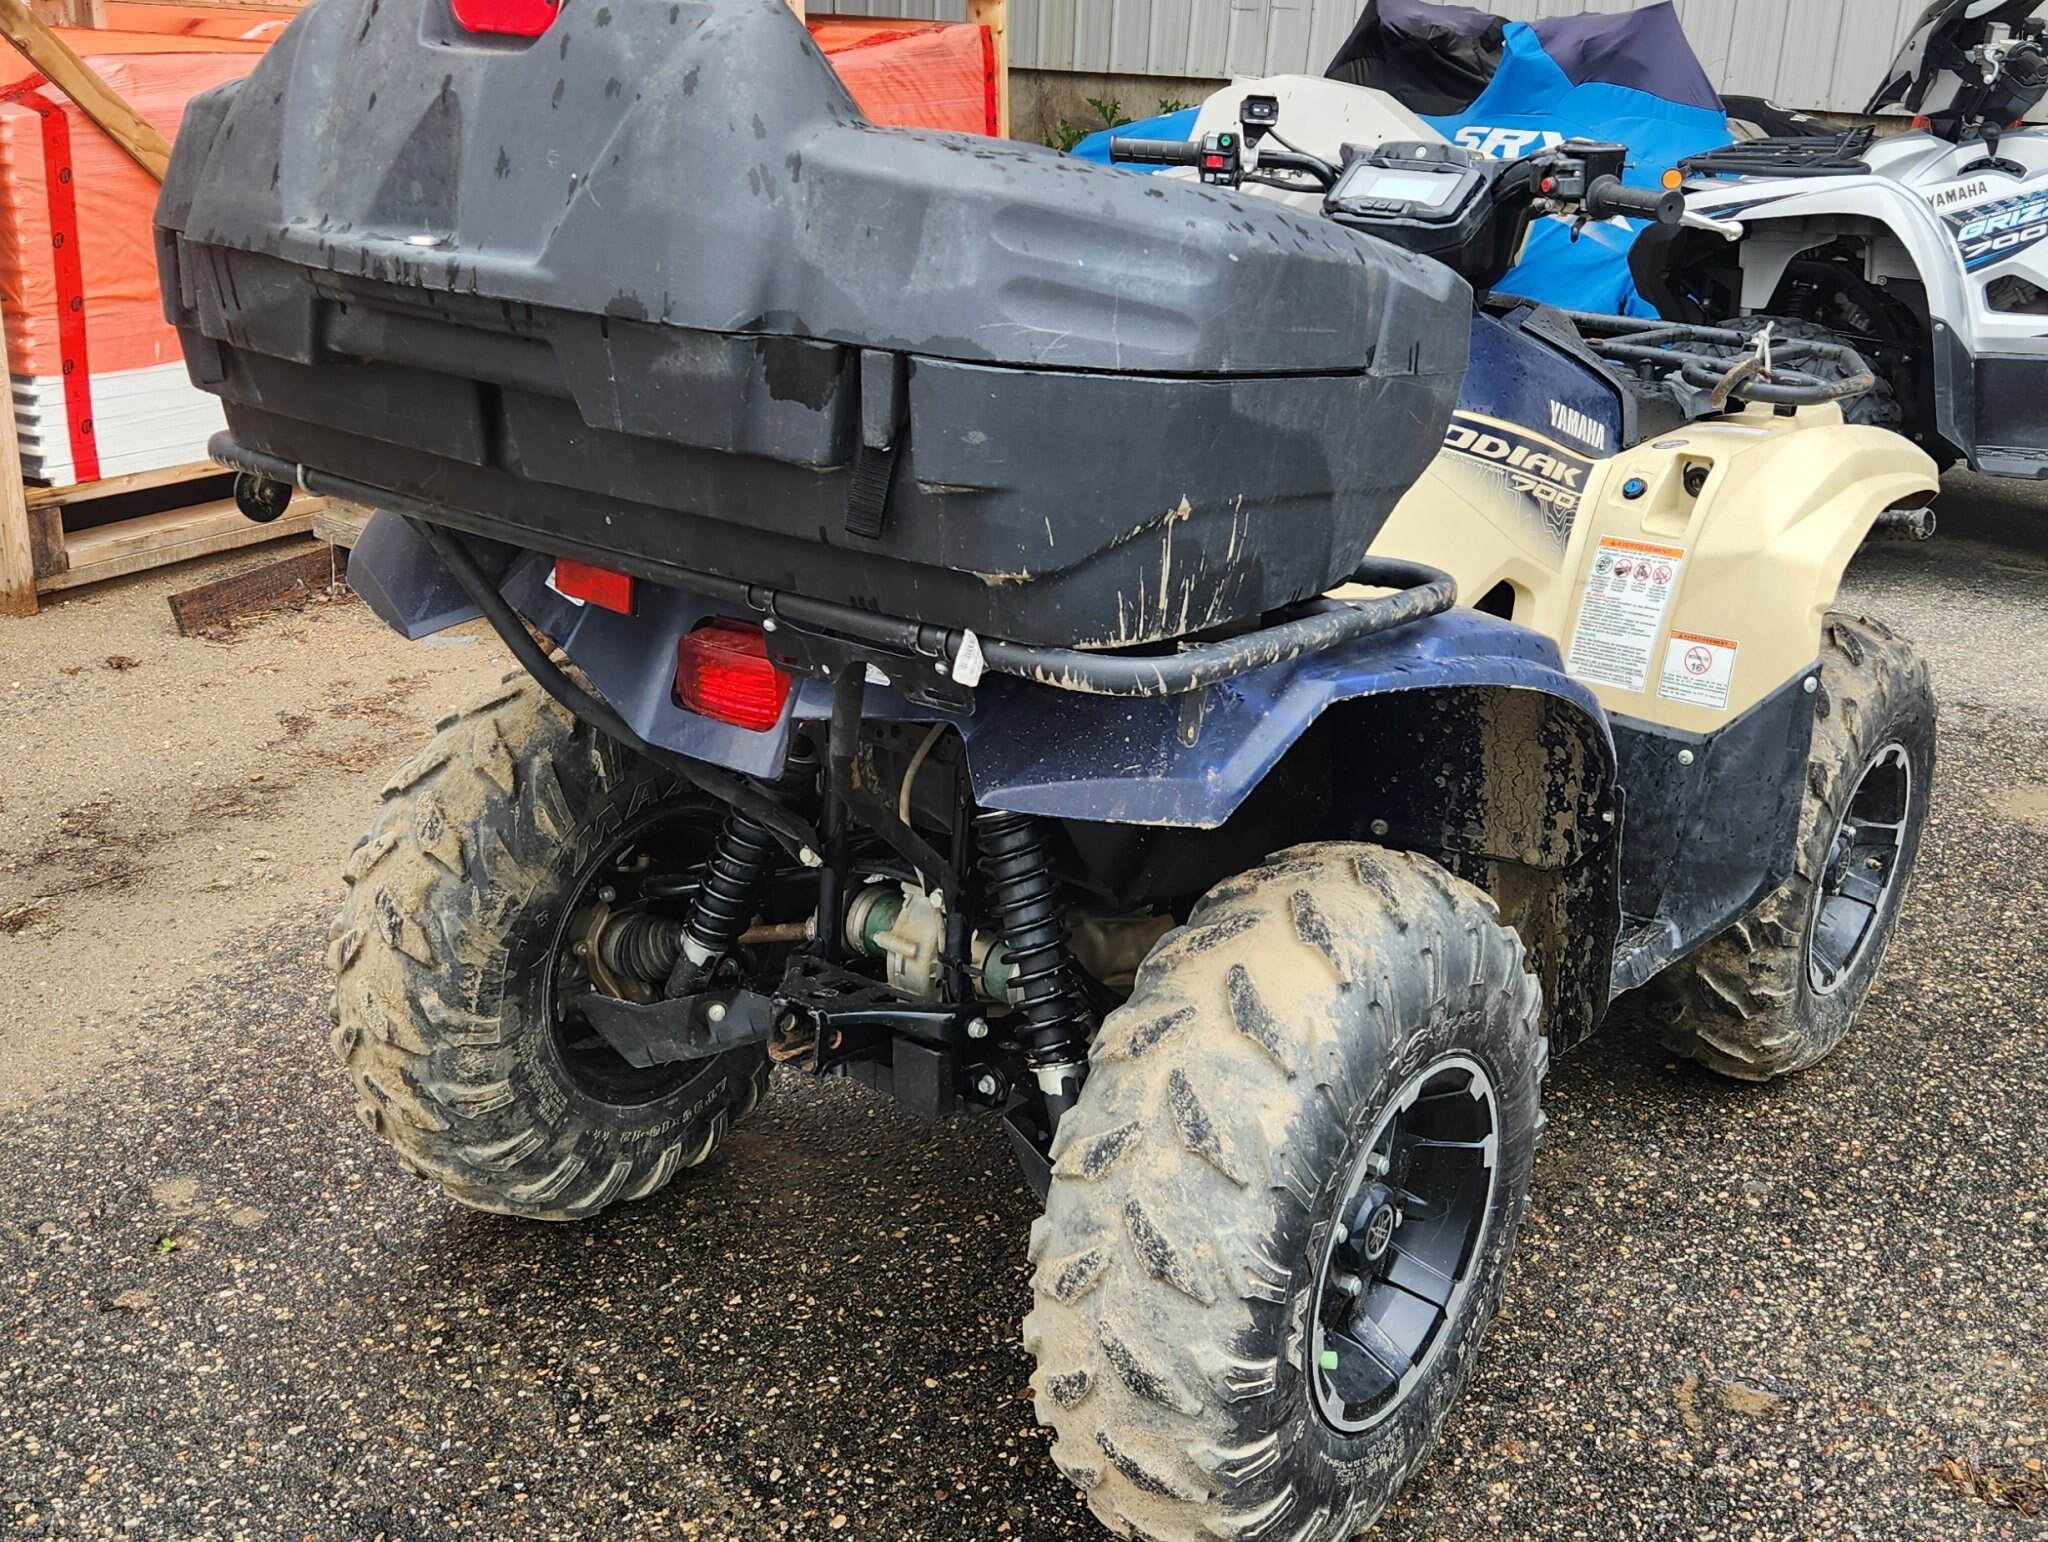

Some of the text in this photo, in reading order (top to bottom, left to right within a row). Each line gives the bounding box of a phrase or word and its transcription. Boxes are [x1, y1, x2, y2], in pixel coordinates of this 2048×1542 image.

[1927, 181, 1988, 207] YAMAHA
[1965, 224, 2048, 259] 700
[1550, 399, 1605, 450] YAMAHA
[1444, 424, 1582, 487] ODIAK
[1511, 475, 1577, 509] 700
[1691, 663, 1702, 672] 16
